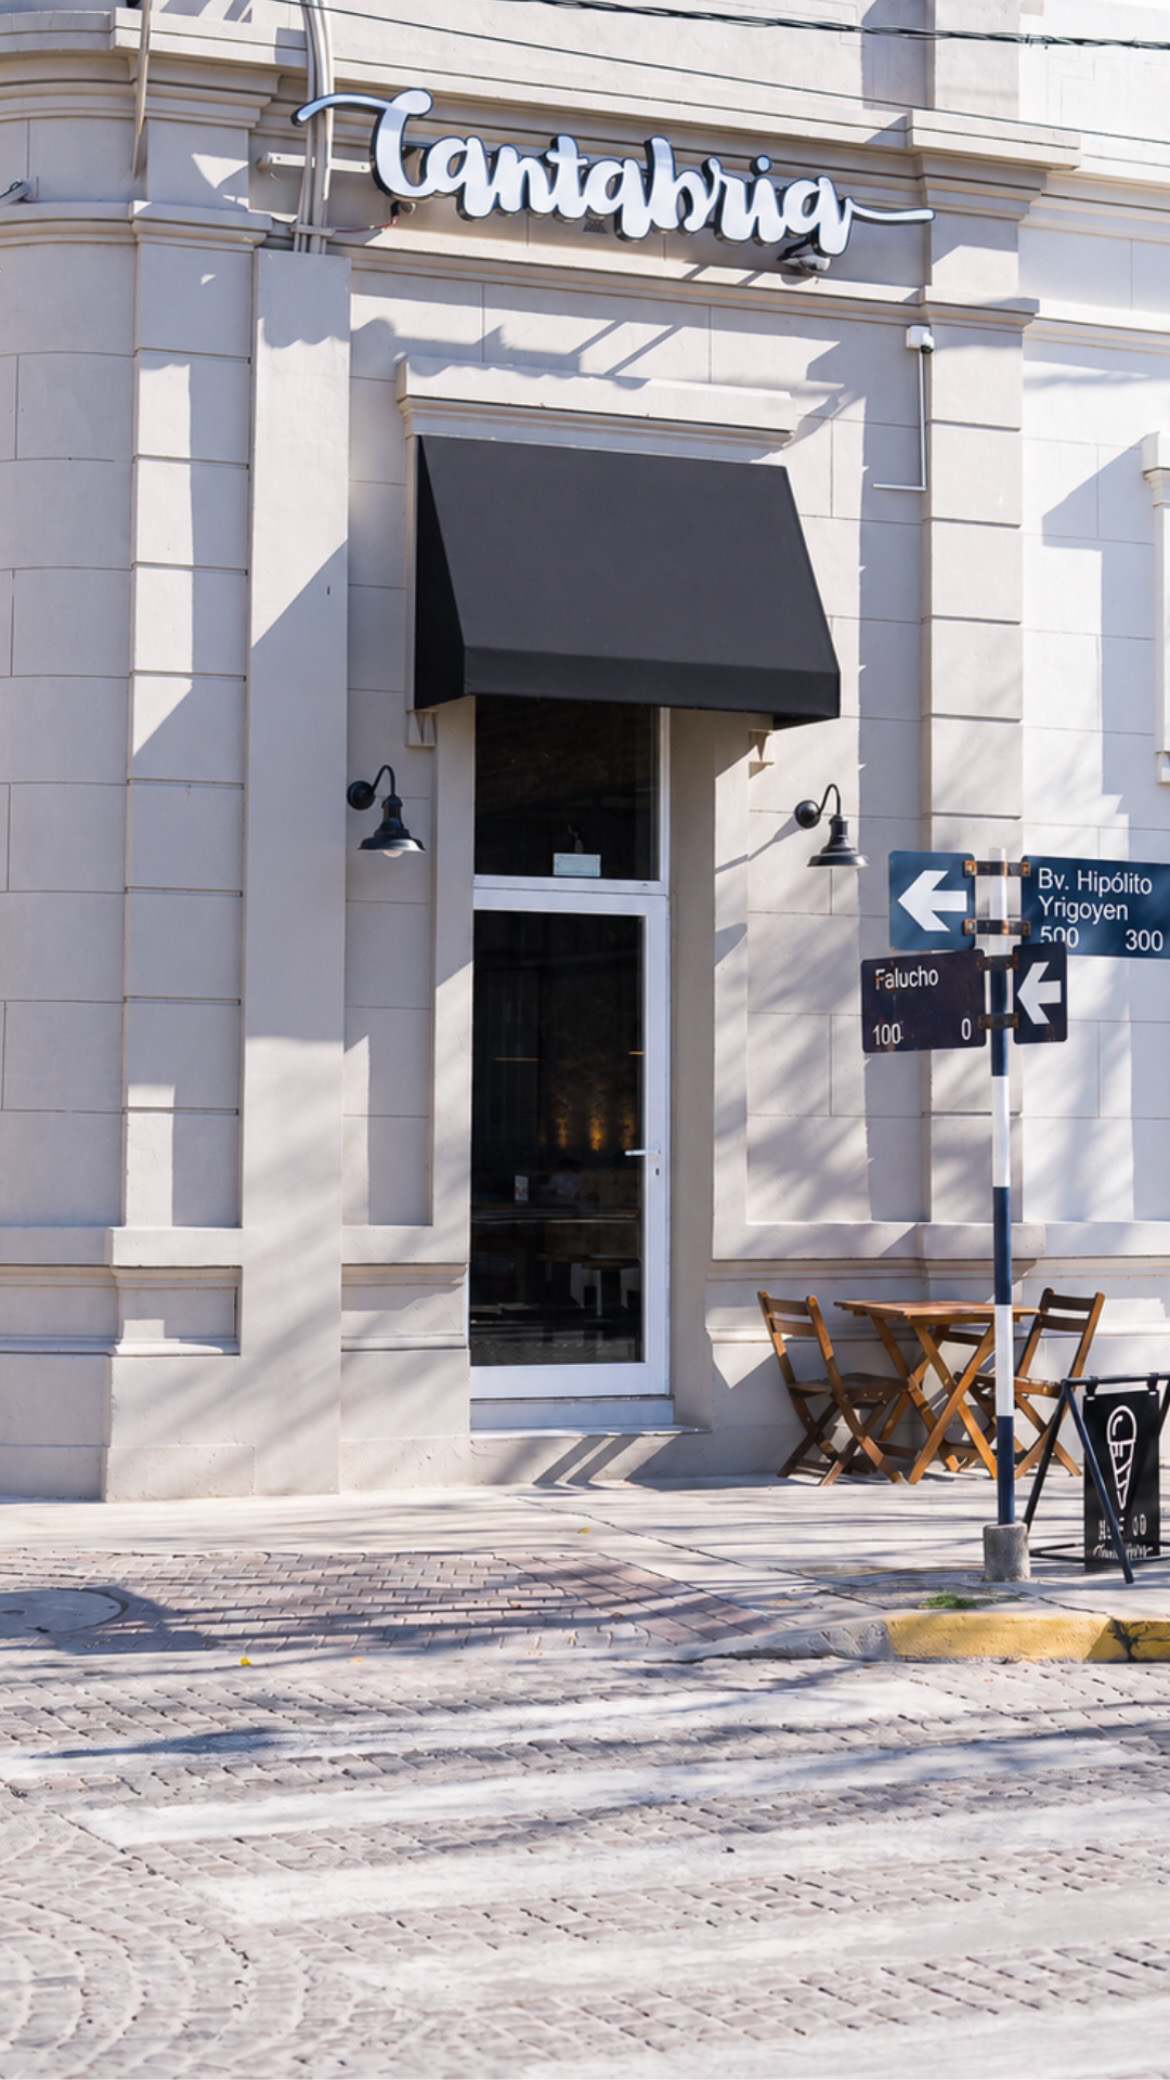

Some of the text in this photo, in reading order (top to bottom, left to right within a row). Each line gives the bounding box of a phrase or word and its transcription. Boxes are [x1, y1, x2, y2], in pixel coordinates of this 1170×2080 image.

[290, 88, 936, 256] Cantabria
[1038, 867, 1153, 897] Bv. Hipólito
[1038, 895, 1129, 925] Yrigoyen
[1040, 925, 1164, 951] 500 300
[875, 966, 939, 990] Falucho
[872, 1018, 972, 1046] 100 0
